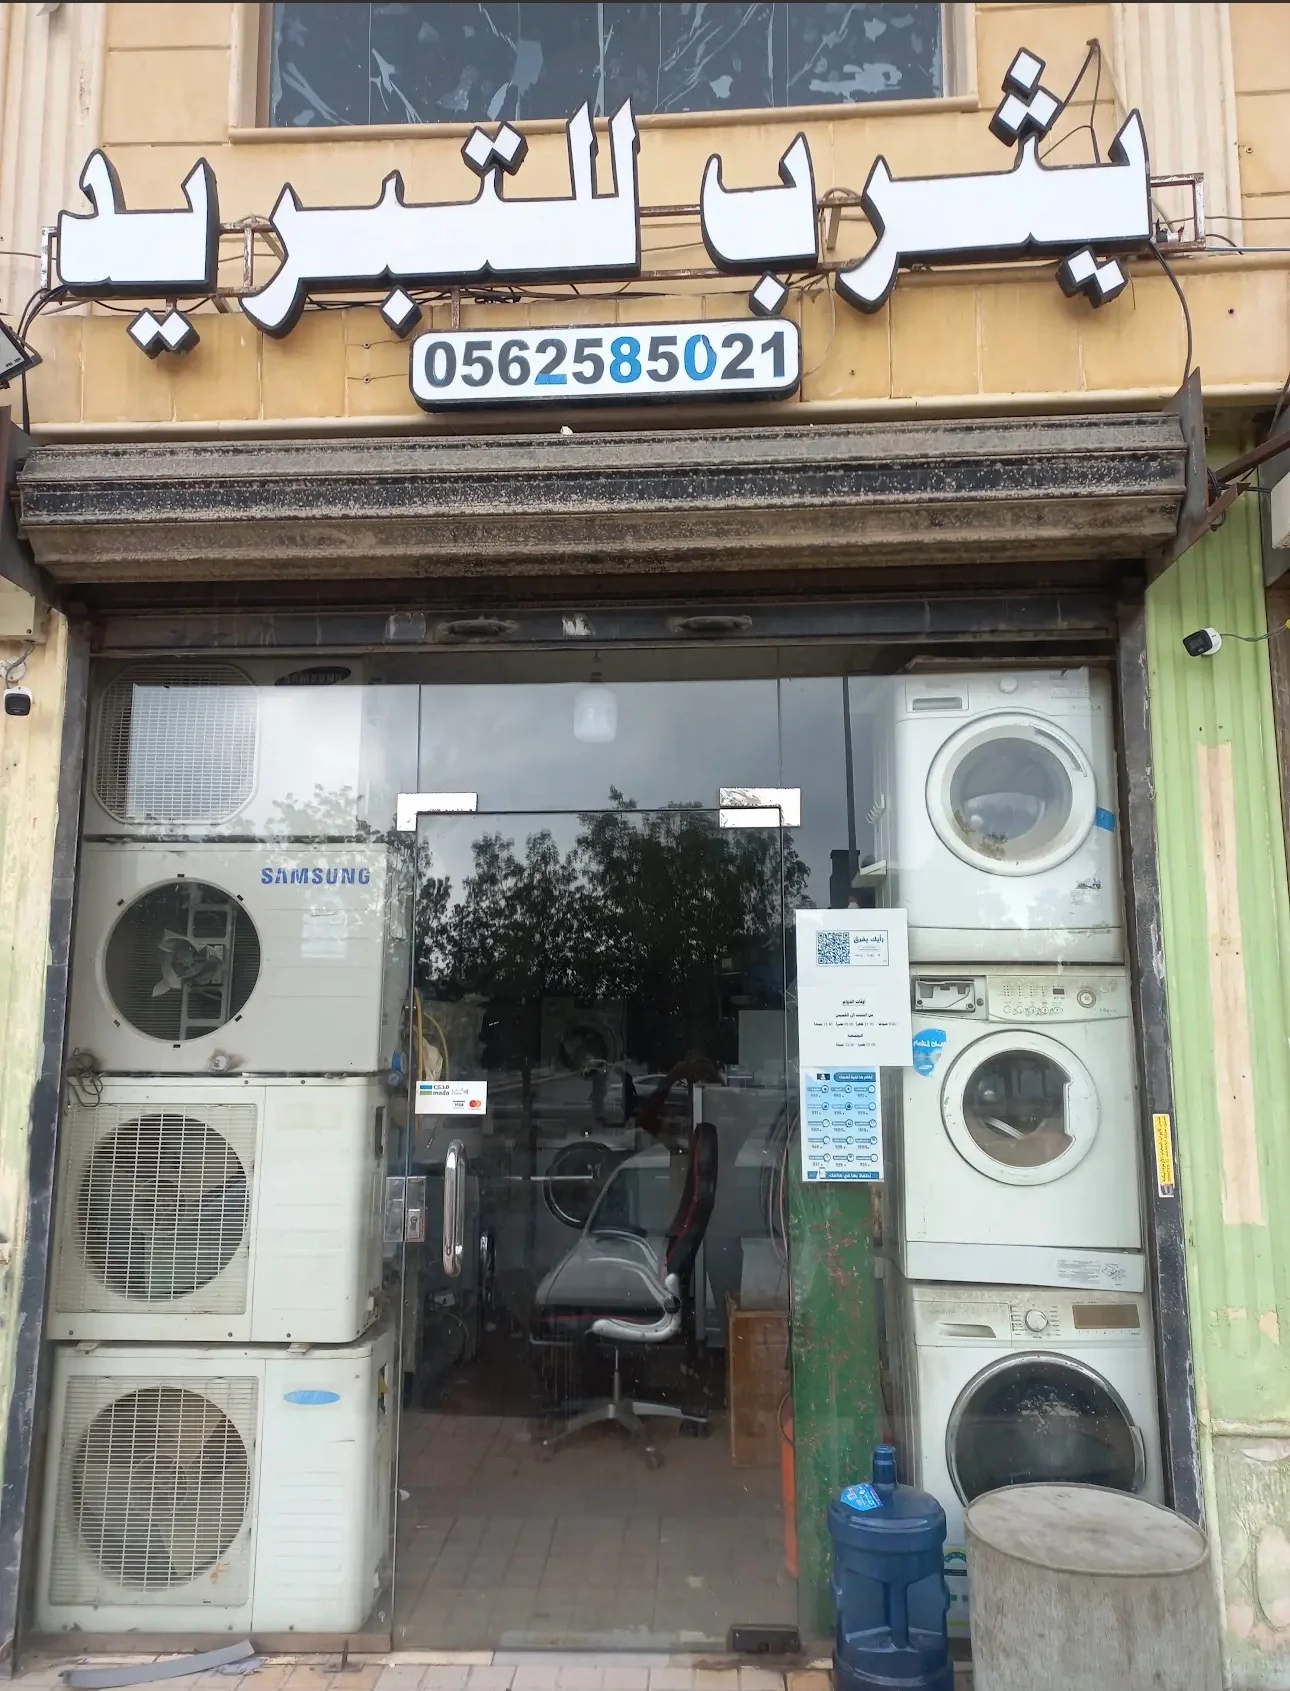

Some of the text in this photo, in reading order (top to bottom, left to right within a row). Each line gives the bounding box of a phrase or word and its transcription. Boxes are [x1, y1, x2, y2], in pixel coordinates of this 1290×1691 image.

[56, 47, 1152, 359] يثرب للتبريد
[424, 331, 787, 387] 0562585021
[260, 867, 371, 885] SAMSUNG
[853, 934, 884, 944] رأيك يفرق
